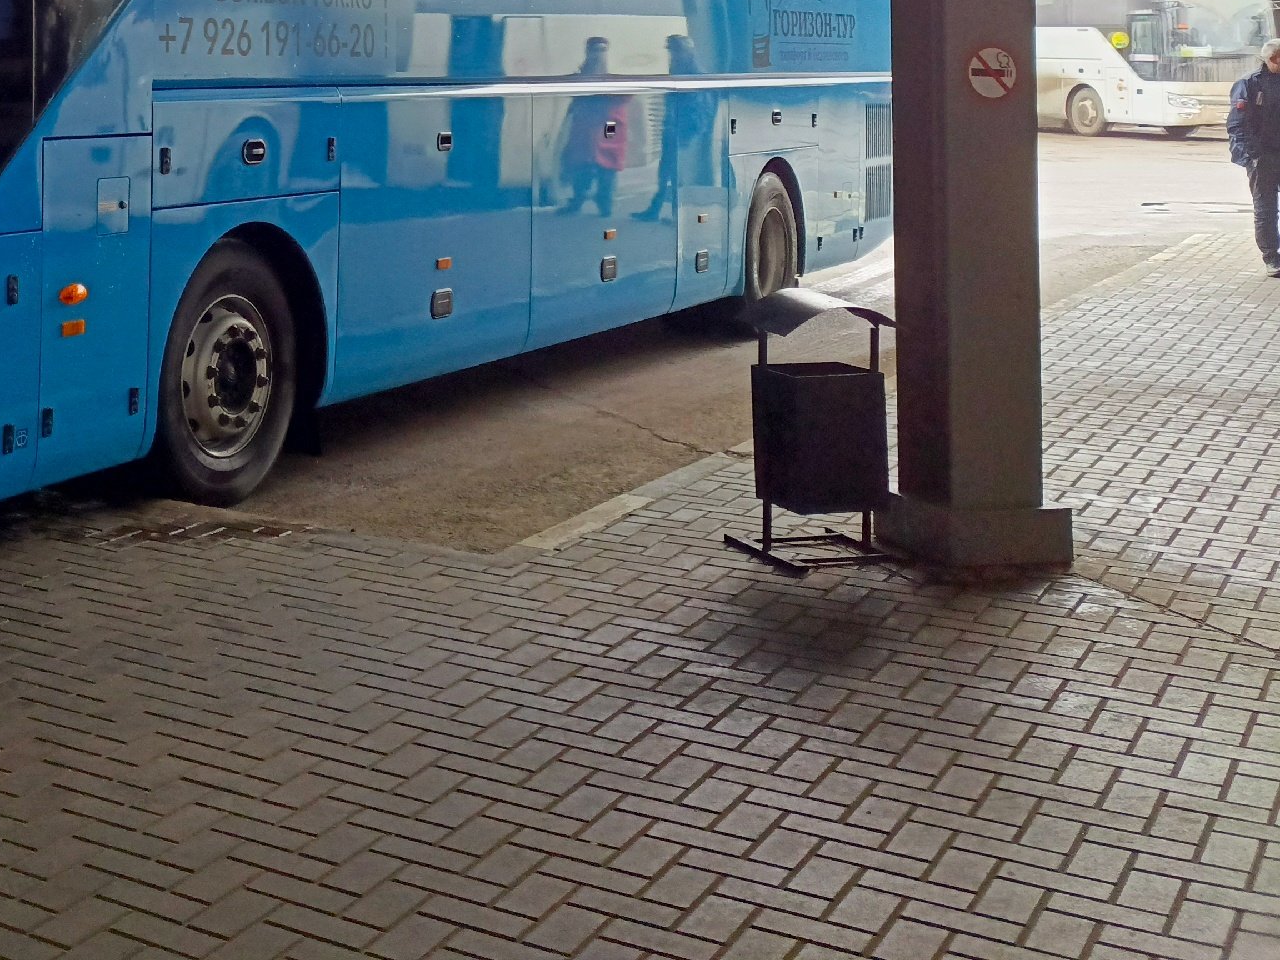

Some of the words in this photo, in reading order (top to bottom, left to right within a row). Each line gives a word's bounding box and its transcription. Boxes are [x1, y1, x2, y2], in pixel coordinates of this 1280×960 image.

[159, 17, 194, 55] +7
[203, 18, 252, 57] 926
[261, 20, 375, 58] 191-66-20
[772, 9, 856, 38] ГОРИЗОН-ТУР
